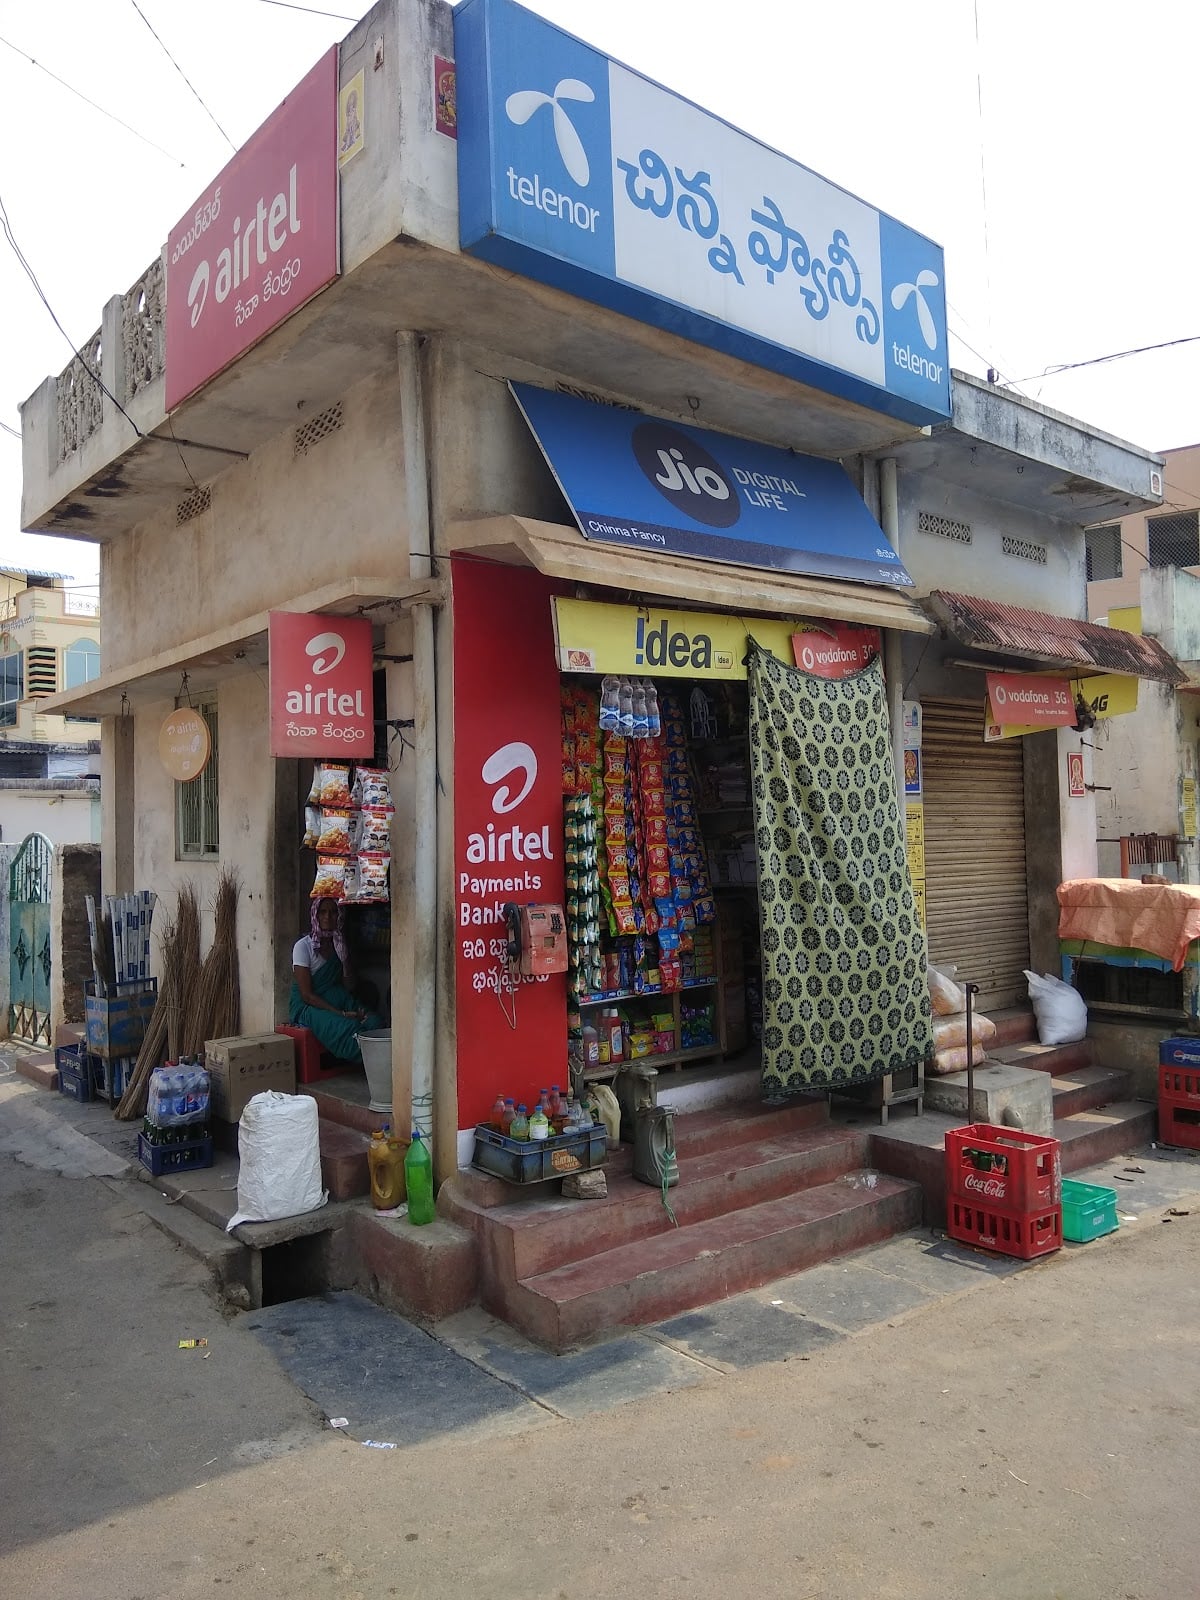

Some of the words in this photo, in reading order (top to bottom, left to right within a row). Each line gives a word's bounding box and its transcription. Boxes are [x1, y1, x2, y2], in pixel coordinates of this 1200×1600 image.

[506, 166, 601, 233] telenor
[616, 149, 745, 286] చిన్న
[215, 163, 301, 304] airtel
[892, 341, 943, 385] telenor
[655, 447, 729, 500] Jio
[732, 467, 807, 498] DIGITAL
[744, 489, 788, 512] LIFE
[588, 520, 631, 537] Chinna
[631, 527, 666, 545] Fancy
[815, 648, 858, 663] vodafone
[285, 683, 365, 717] airtel
[1007, 690, 1049, 704] vodafone
[1053, 690, 1068, 705] 3G
[1090, 694, 1109, 714] 4G
[286, 721, 318, 737] సేవా
[322, 721, 365, 743] కేంద్రం
[466, 822, 554, 864] airtel
[460, 871, 542, 898] Payments
[460, 901, 506, 926] Bank
[964, 1173, 1006, 1198] Coca-Cola
